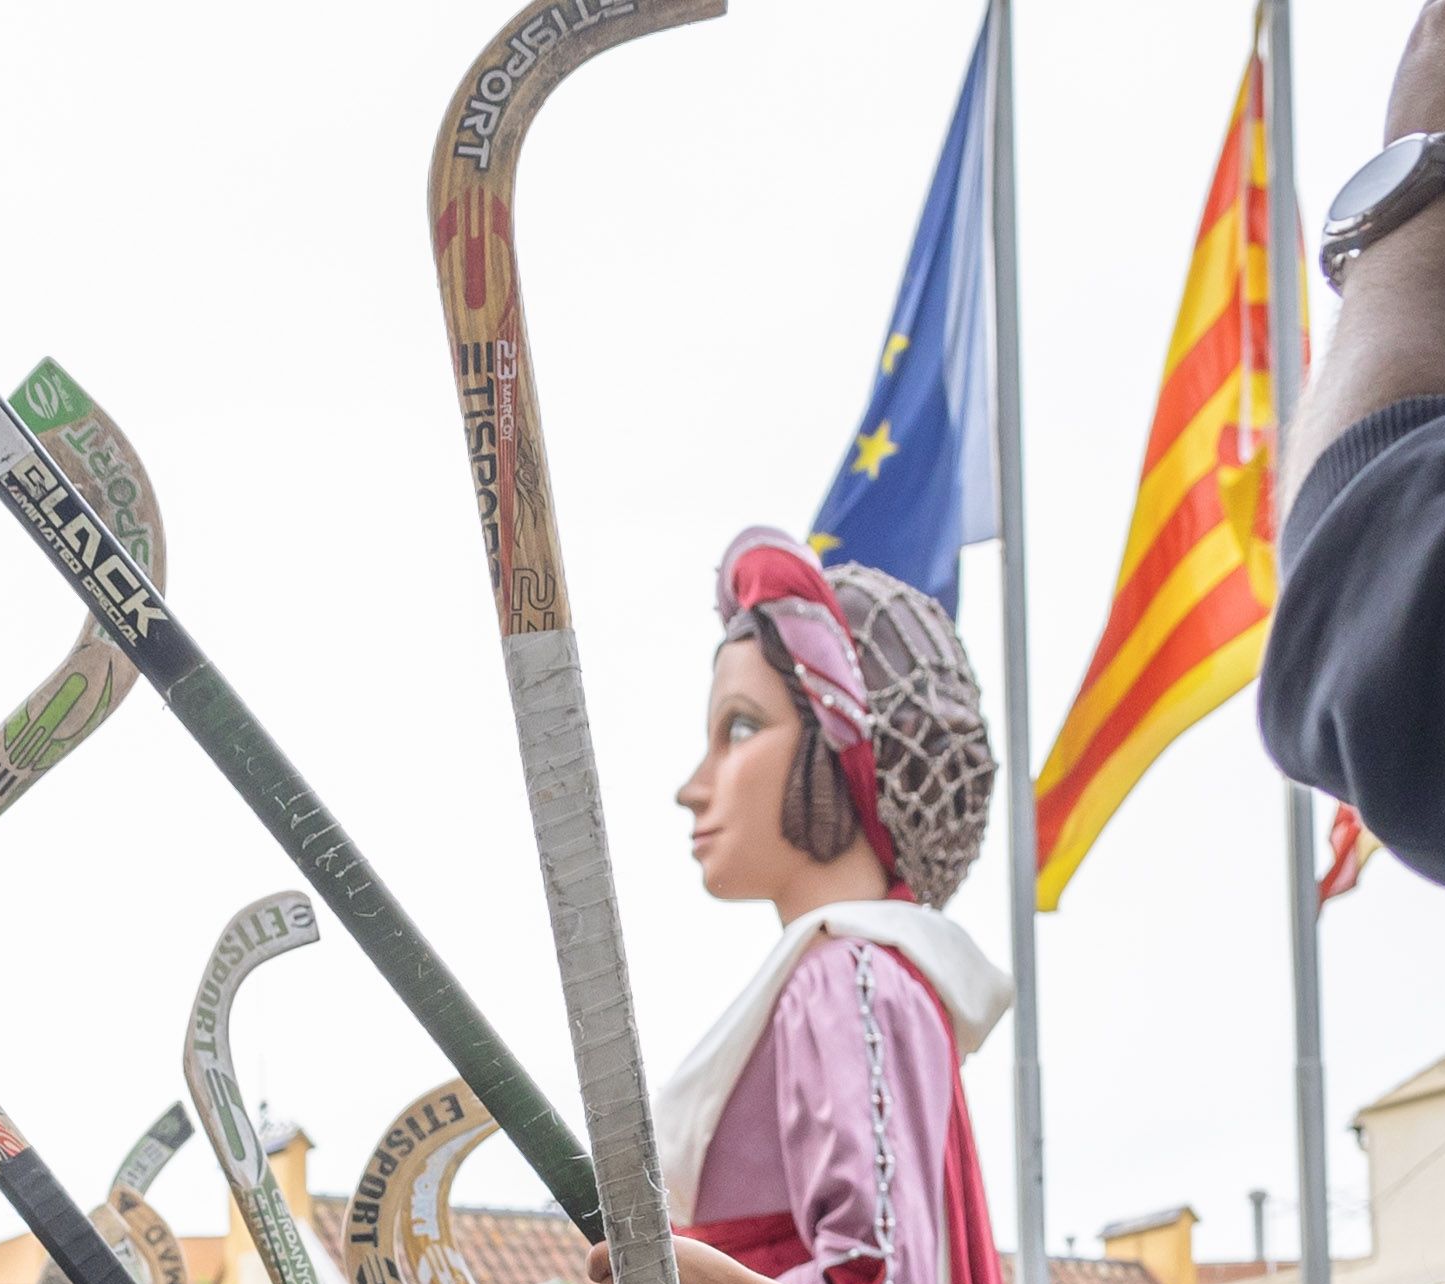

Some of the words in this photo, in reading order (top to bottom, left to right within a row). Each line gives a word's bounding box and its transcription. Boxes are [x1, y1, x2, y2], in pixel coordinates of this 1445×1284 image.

[14, 450, 169, 639] BLACK
[82, 575, 139, 648] SPECIAL
[193, 904, 289, 1060] ETISPORT
[348, 1091, 465, 1249] ETISPORT
